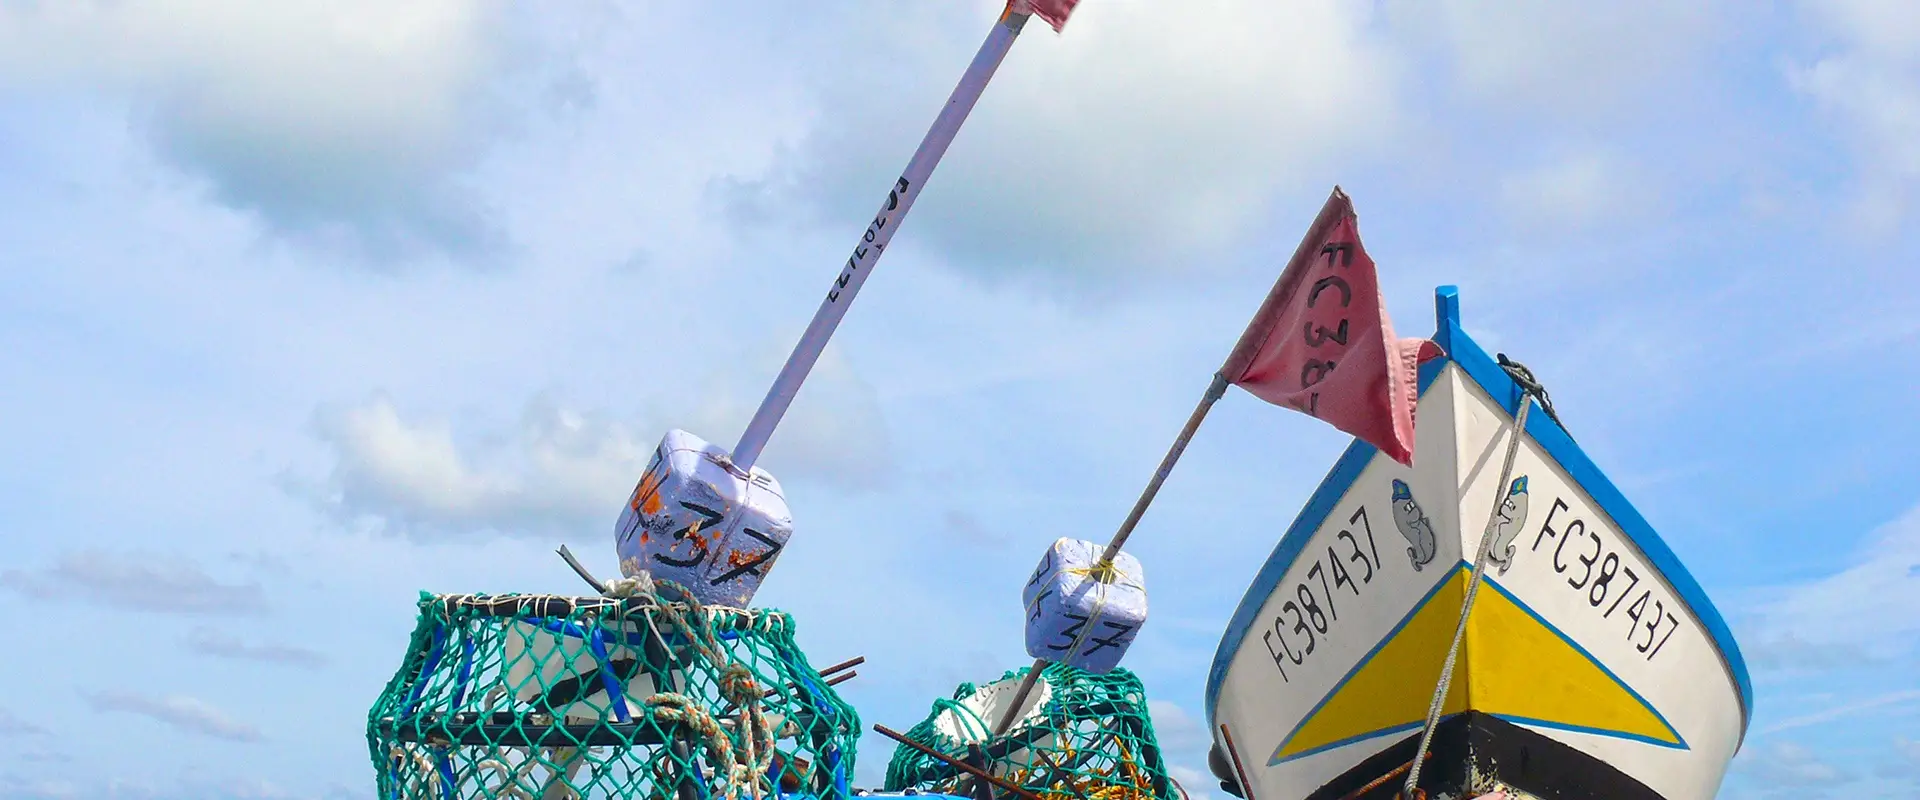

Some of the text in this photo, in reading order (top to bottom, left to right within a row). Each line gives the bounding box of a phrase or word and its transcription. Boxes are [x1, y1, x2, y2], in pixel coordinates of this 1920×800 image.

[652, 500, 782, 587] 37
[1262, 504, 1381, 683] FC387437
[1532, 496, 1680, 661] FC387437
[1047, 612, 1134, 657] 37
